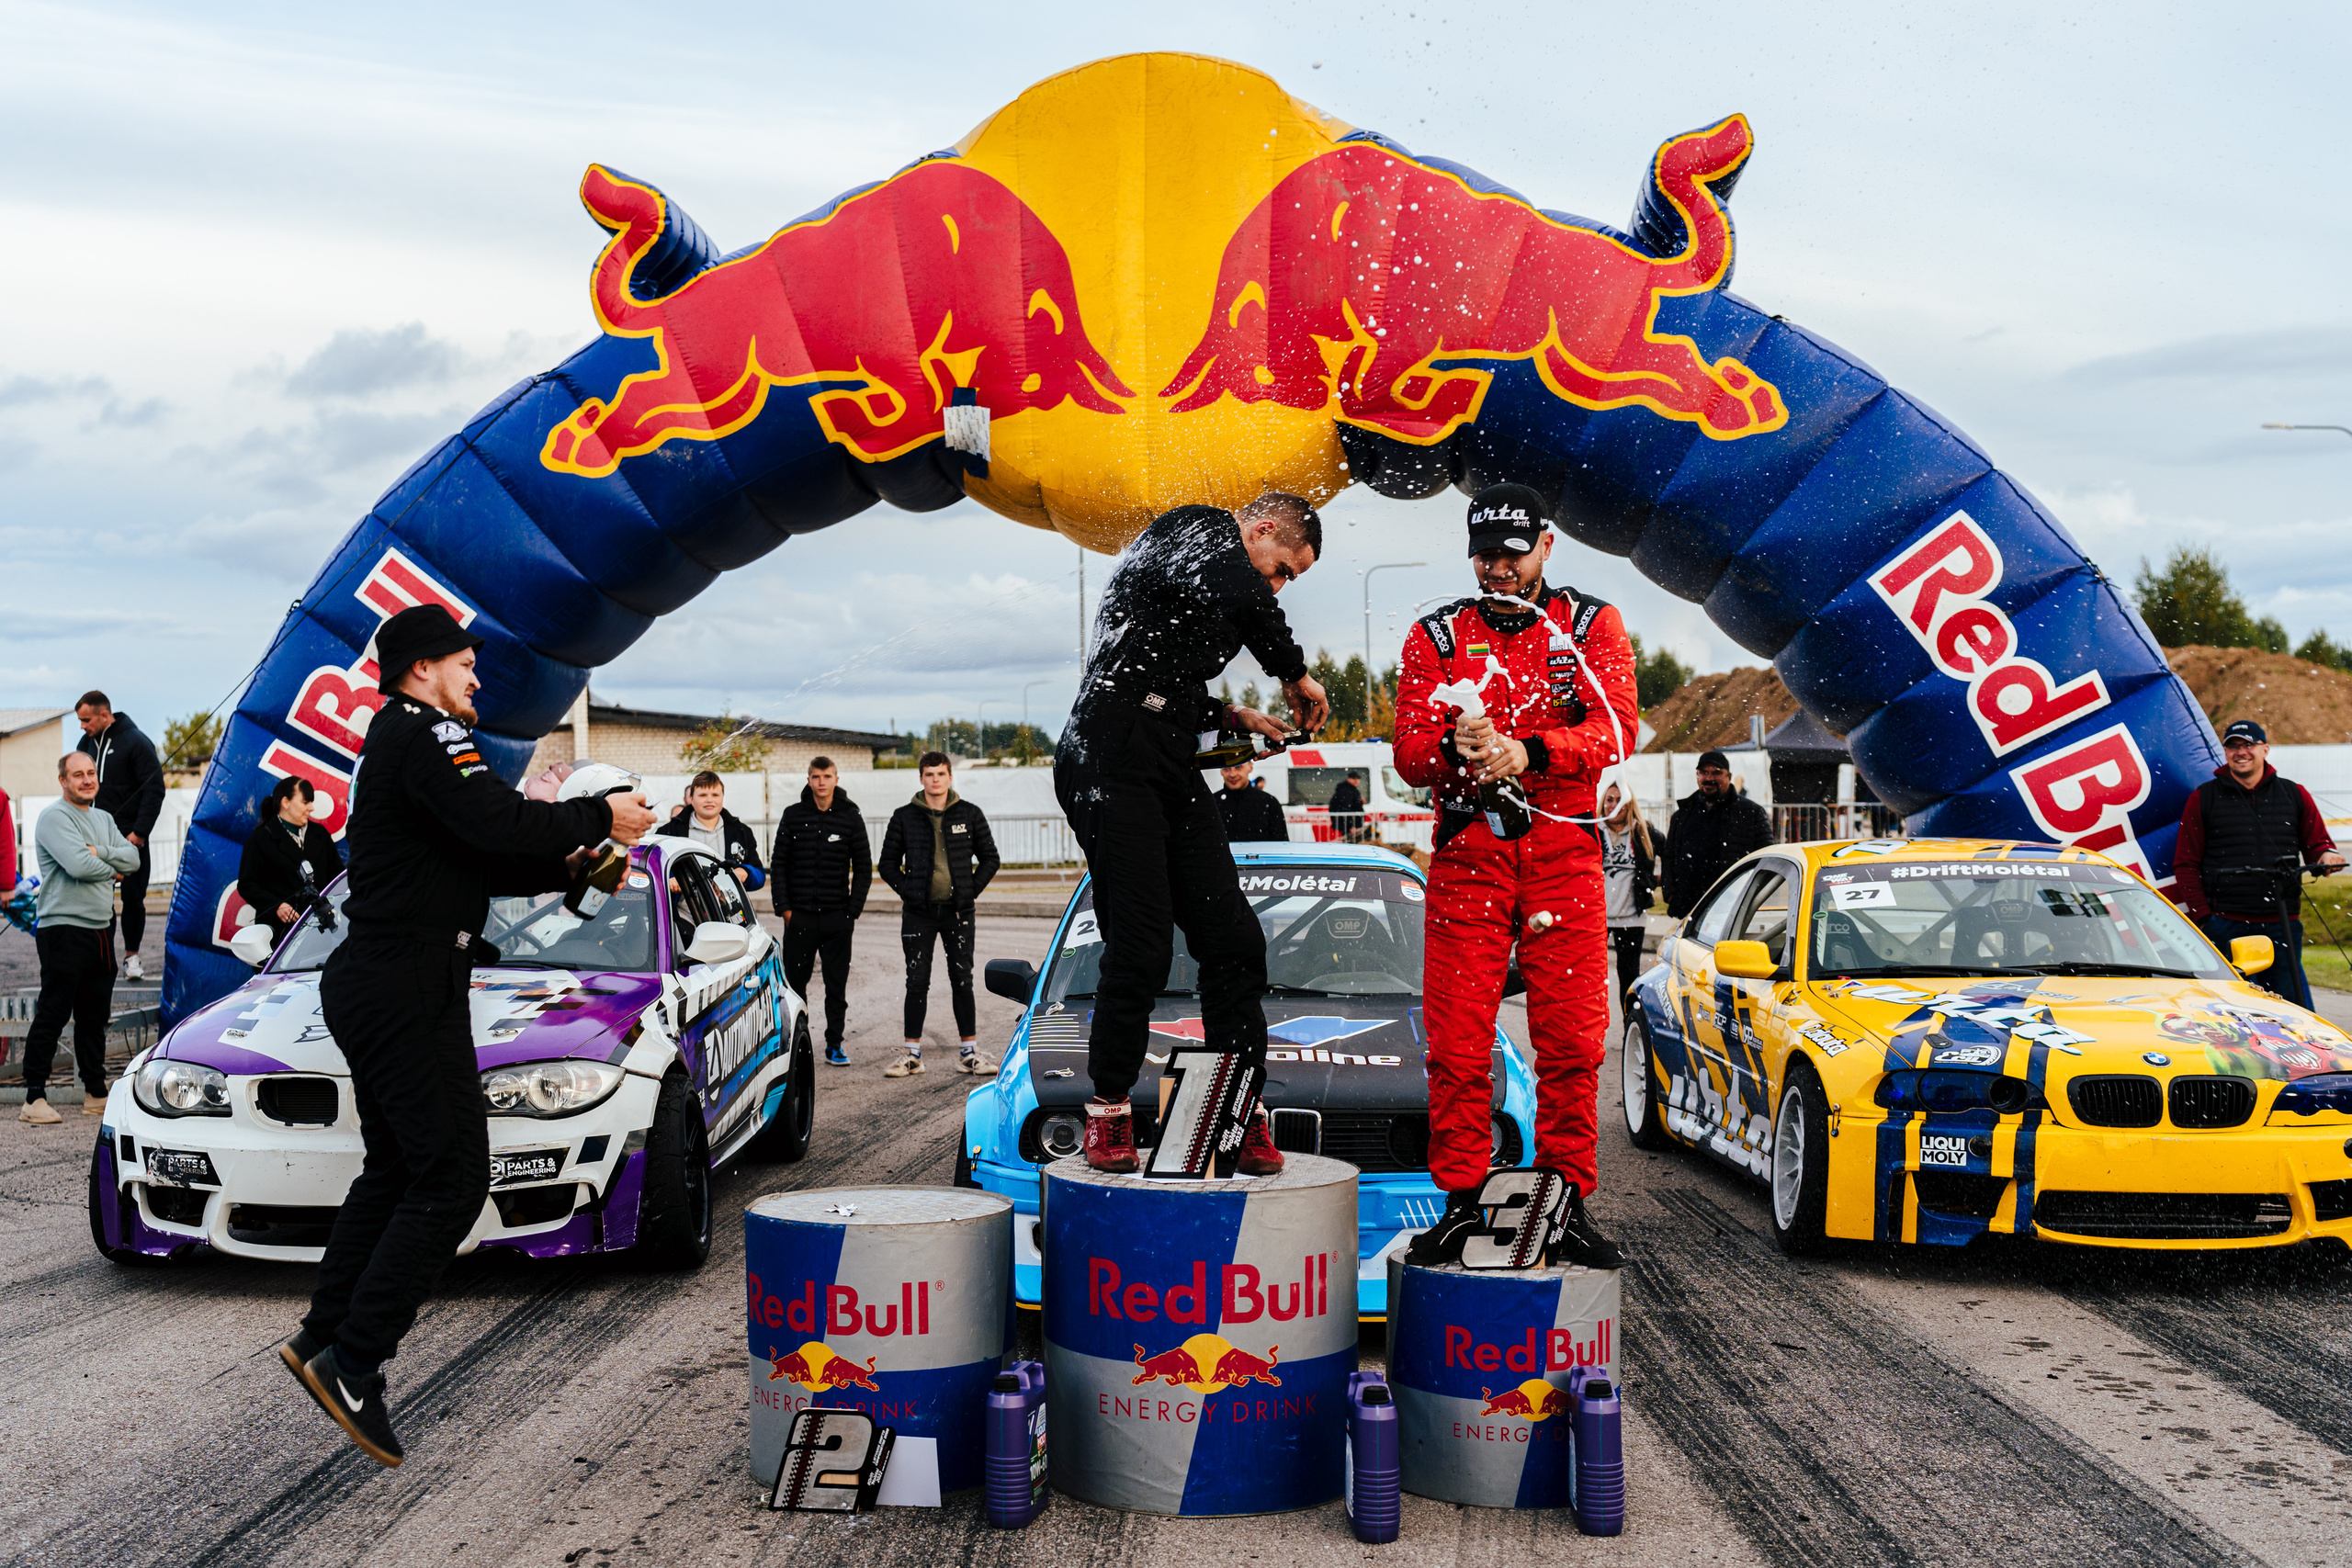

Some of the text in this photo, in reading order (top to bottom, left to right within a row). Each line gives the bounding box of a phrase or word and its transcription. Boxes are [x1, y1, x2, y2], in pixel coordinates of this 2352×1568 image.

[1471, 503, 1529, 525] urta
[1513, 519, 1531, 528] drift
[1574, 605, 1599, 637] sparco
[1428, 619, 1451, 653] sparco
[1866, 509, 2111, 758] Red
[286, 547, 478, 764] Bll
[1146, 694, 1166, 707] OMP
[1845, 889, 1880, 901] 27
[1334, 920, 1361, 931] OMP
[1233, 1126, 1245, 1147] 2022
[1921, 1135, 1966, 1151] LIQUI
[199, 1159, 208, 1169] &
[507, 1157, 557, 1171] PARTS &
[1922, 1150, 1965, 1165] MOLY
[507, 1167, 557, 1177] ENGINEERING
[1463, 1171, 1564, 1268] 3
[1089, 1253, 1328, 1325] Red Bull
[748, 1273, 930, 1337] Red Bull
[1445, 1318, 1611, 1373] Red Bull
[1099, 1393, 1317, 1424] ENERGY DRINK
[1453, 1422, 1544, 1443] ENERGY
[771, 1413, 873, 1510] 2
